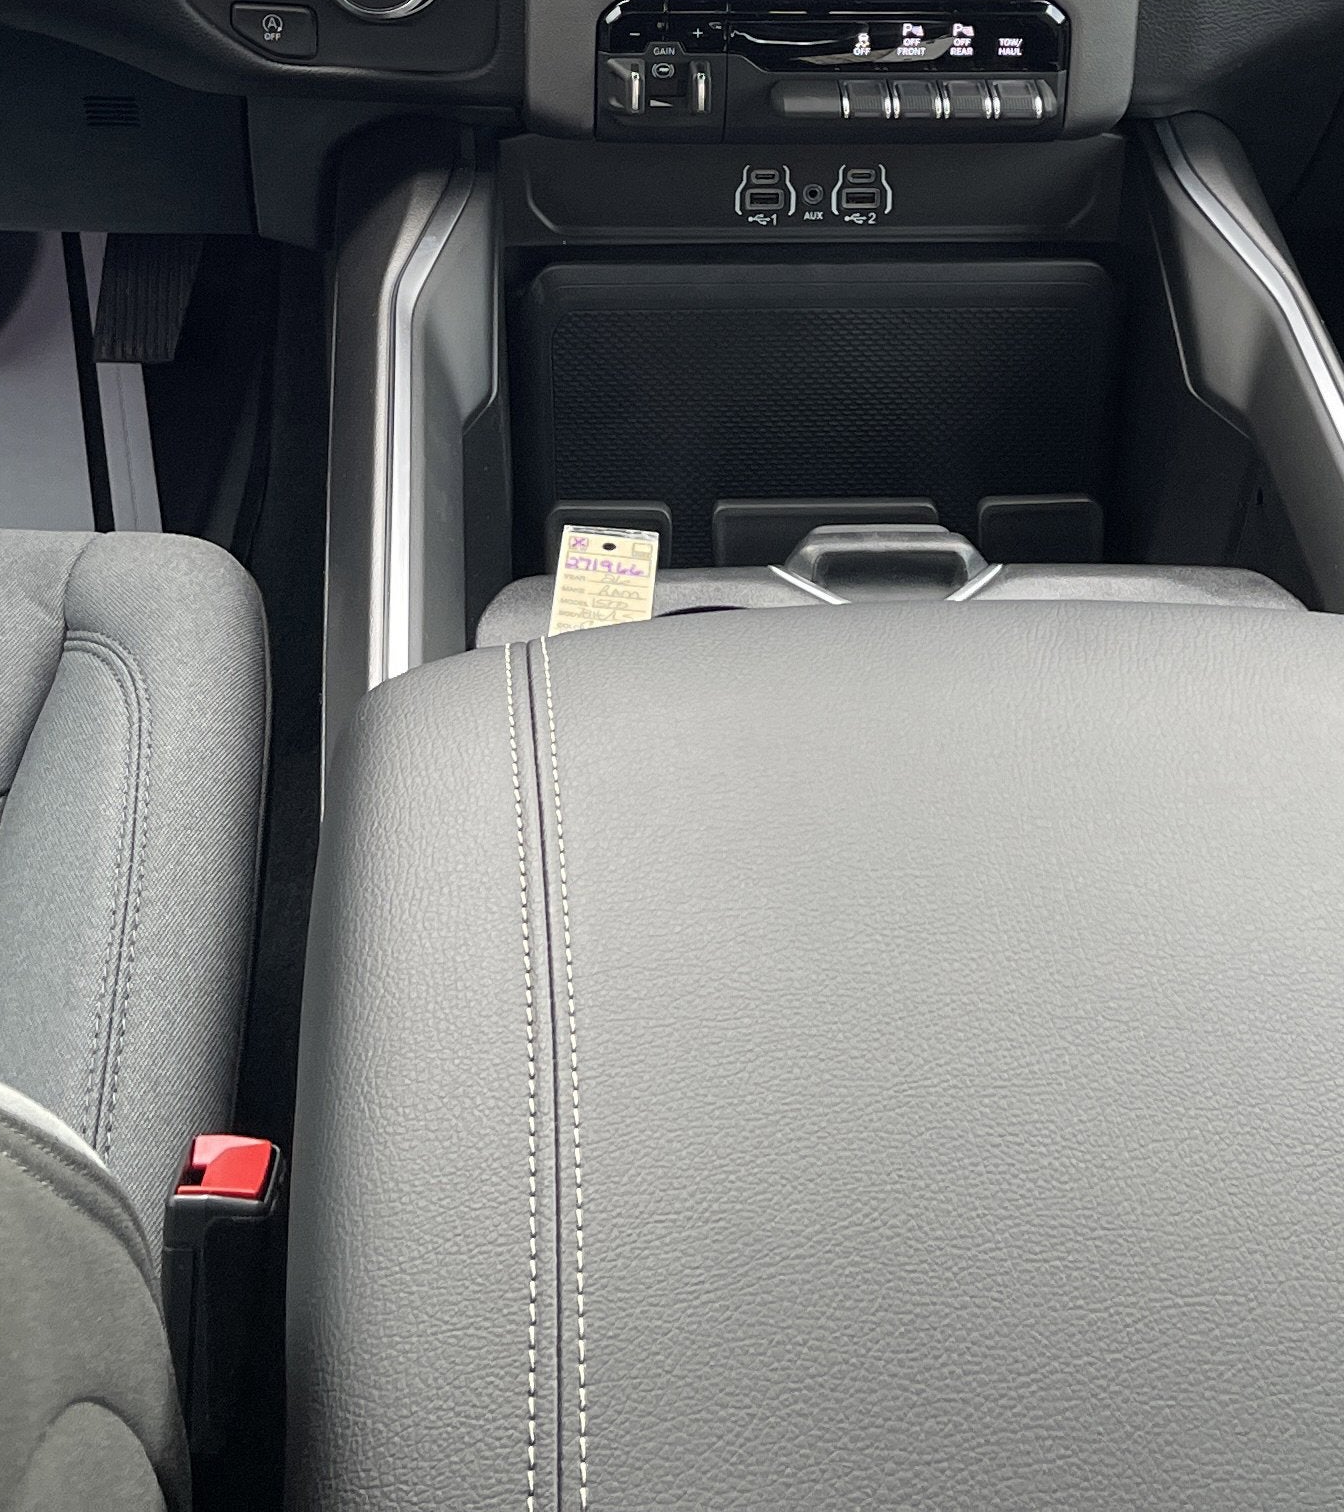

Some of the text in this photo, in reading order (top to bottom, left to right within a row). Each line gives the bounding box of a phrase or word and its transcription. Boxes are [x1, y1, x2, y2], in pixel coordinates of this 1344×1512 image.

[264, 32, 281, 41] OFF
[902, 38, 921, 47] OFF
[953, 38, 971, 47] OFF
[653, 47, 676, 56] GAIN
[853, 47, 871, 56] OFF
[897, 47, 926, 56] FRONT
[950, 47, 974, 56] REAR
[998, 47, 1023, 56] HAUL
[803, 211, 824, 220] AUX
